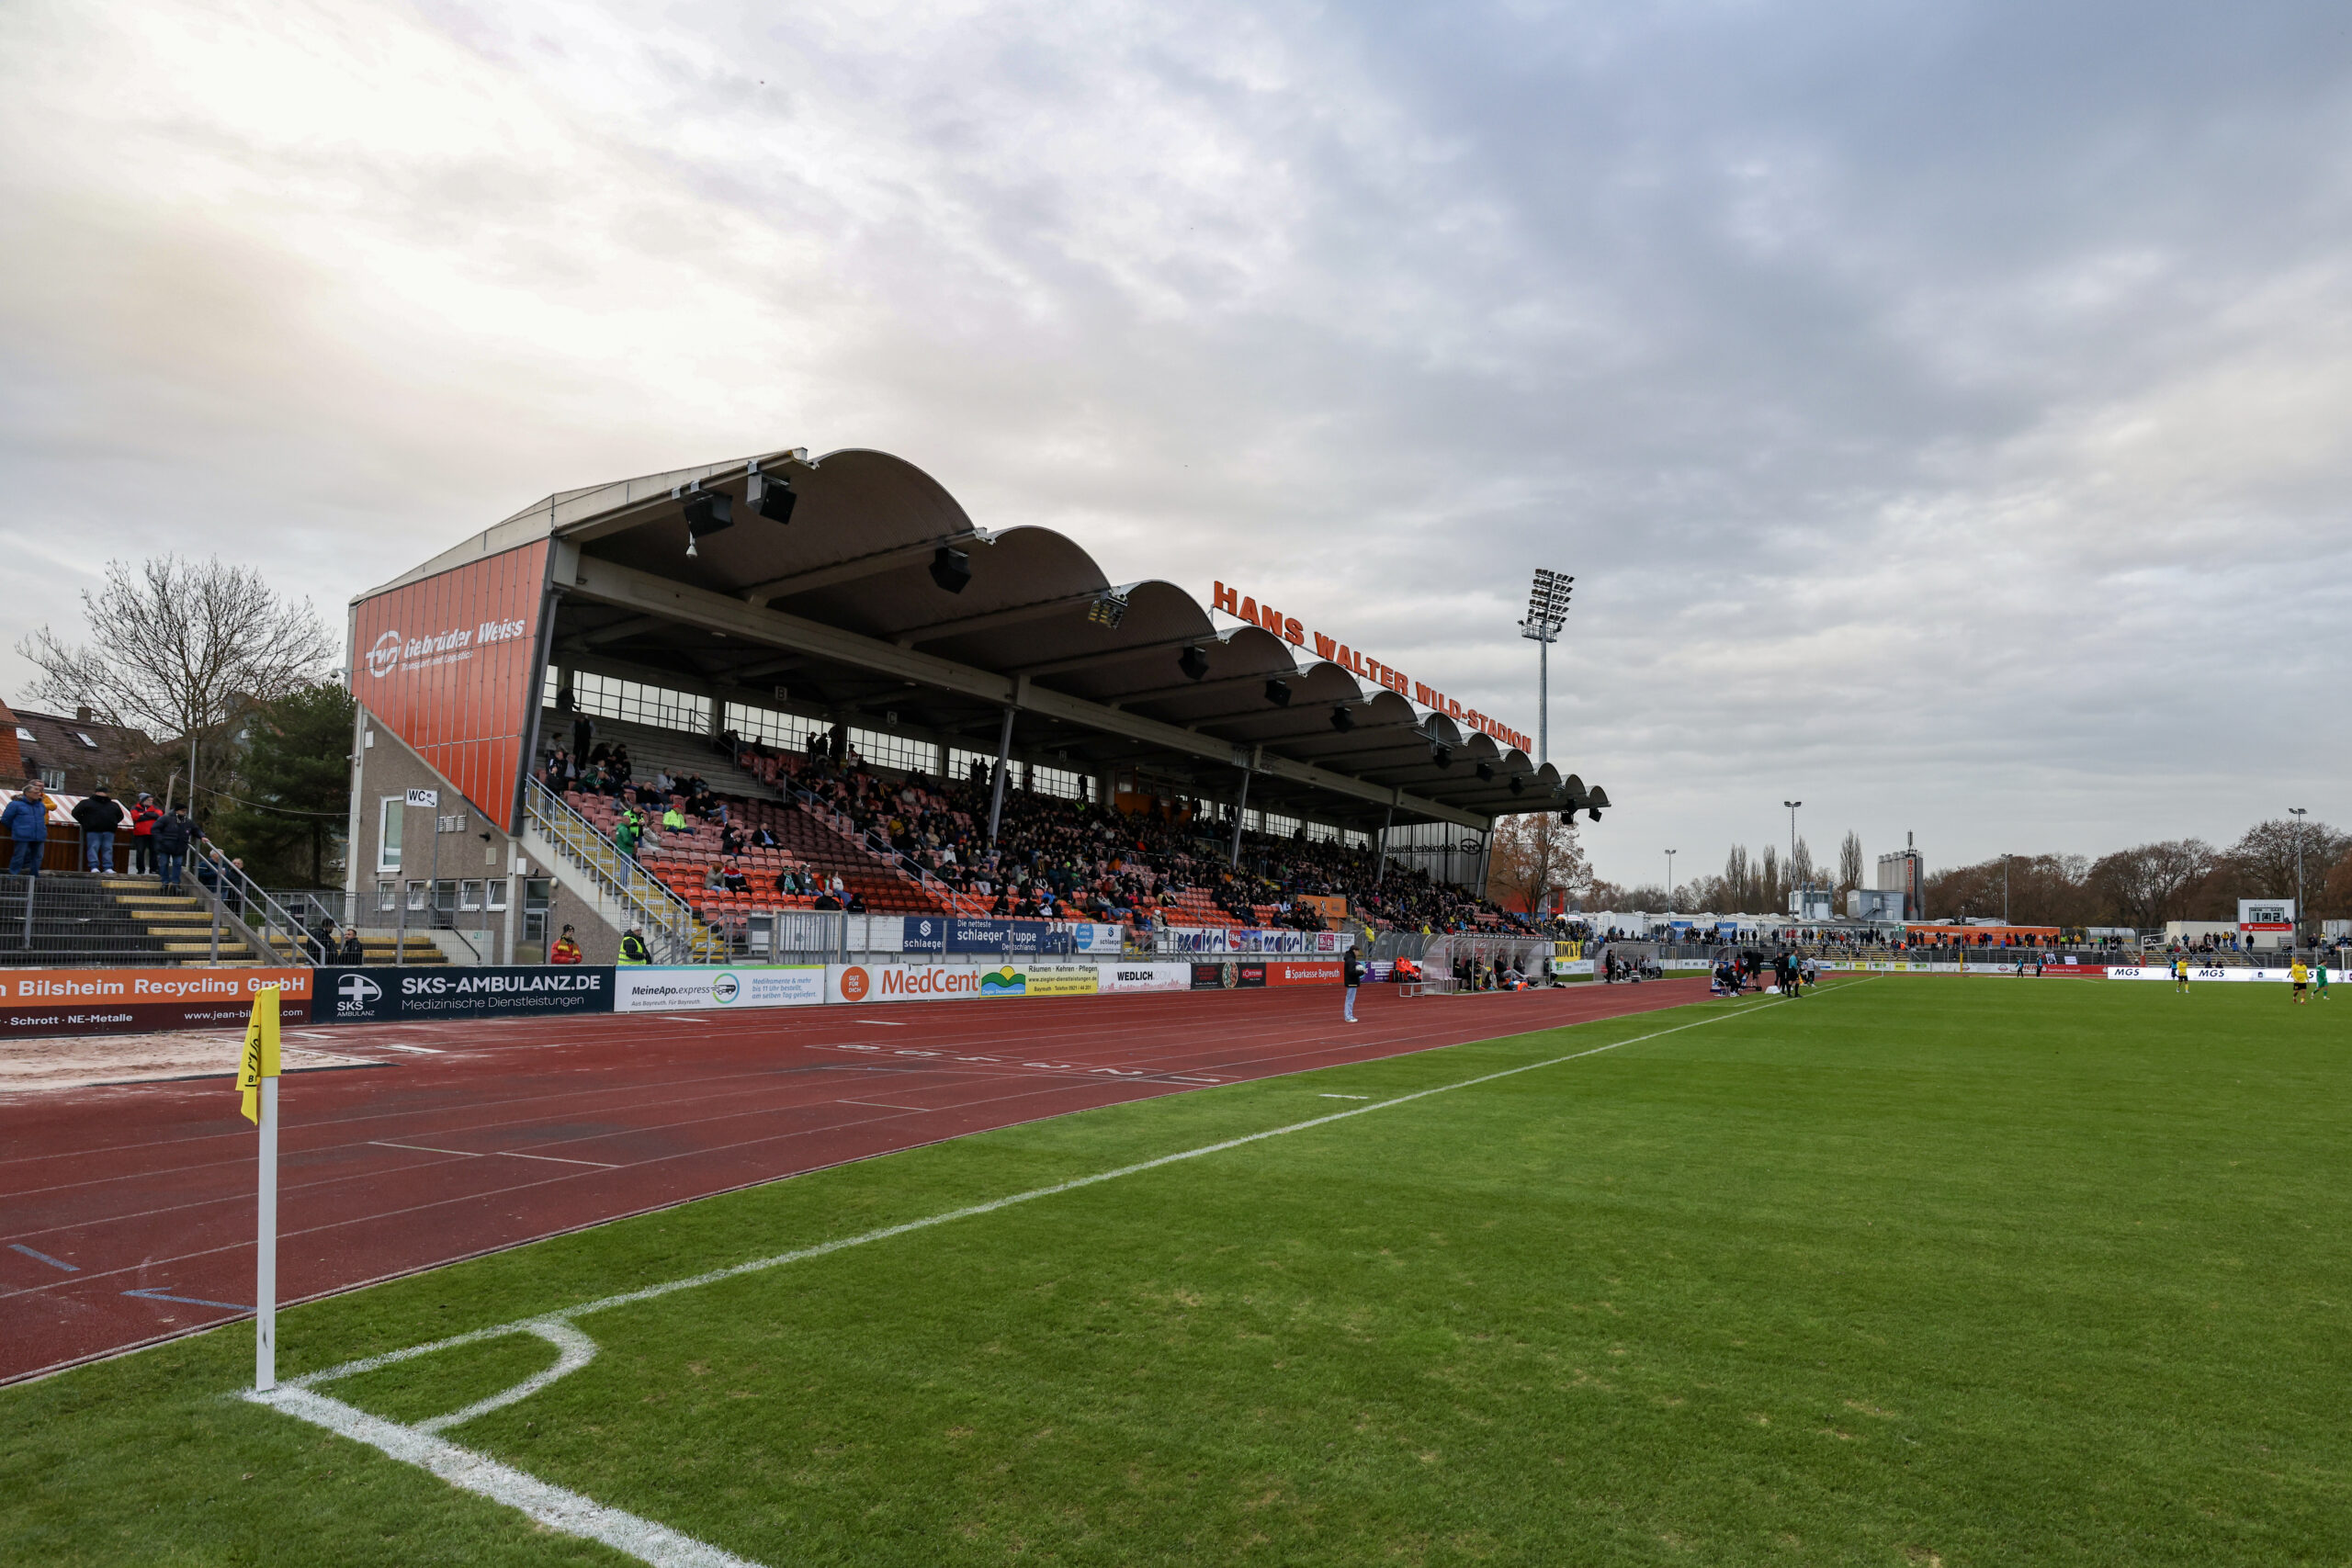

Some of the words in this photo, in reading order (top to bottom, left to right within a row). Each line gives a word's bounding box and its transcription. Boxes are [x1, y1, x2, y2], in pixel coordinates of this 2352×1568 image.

[404, 628, 474, 659] Gebrüder
[478, 618, 526, 644] Weiss
[1214, 581, 1305, 646] HANS
[1314, 631, 1408, 696] WALTER
[1415, 681, 1532, 754] WILD-STADION
[408, 790, 425, 802] WC
[968, 919, 991, 928] netteste
[2273, 912, 2280, 921] 2
[957, 929, 1003, 942] schlaeger
[1555, 942, 1573, 957] BLOCK
[881, 967, 980, 995] MedCent
[1291, 969, 1317, 980] Sparkasse
[1318, 968, 1340, 979] Bayreuth
[18, 979, 124, 997] Bilsheim
[134, 977, 239, 998] Recycling
[247, 976, 305, 991] GmbH
[401, 975, 601, 994] SKS-AMBULANZ.DE
[632, 986, 710, 996] MeineApo.express
[337, 1001, 364, 1010] SKS
[401, 998, 485, 1010] Medizinische
[488, 996, 584, 1009] Dienstleistungen
[10, 1016, 59, 1026] Schrott
[68, 1013, 133, 1024] NE-Metalle
[184, 1010, 303, 1021] www.jean-bil.com
